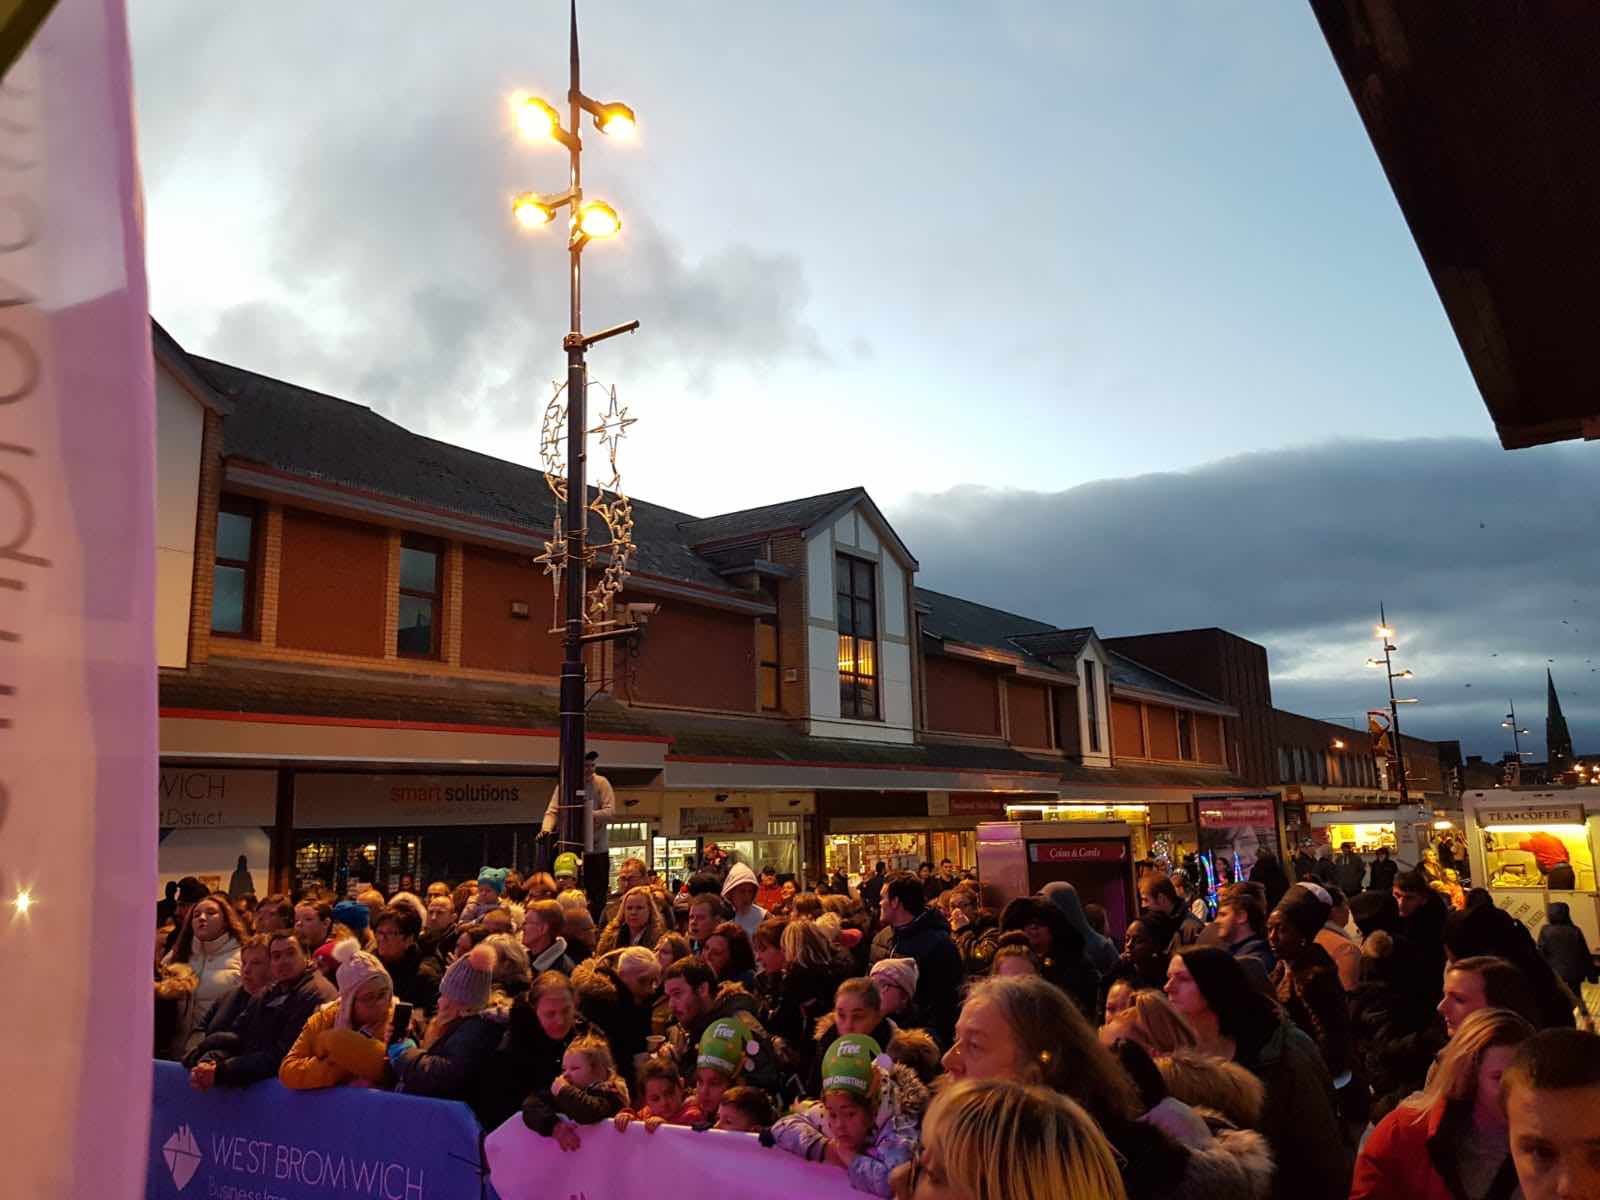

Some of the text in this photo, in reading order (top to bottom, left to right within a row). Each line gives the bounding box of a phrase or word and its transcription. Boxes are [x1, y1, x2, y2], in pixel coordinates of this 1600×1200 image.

[390, 784, 519, 801] smart solutions
[167, 808, 223, 825] District
[1487, 810, 1570, 822] TEA COFFEE
[713, 1023, 737, 1040] Free
[837, 1040, 862, 1057] Free
[212, 1135, 273, 1174] WEST
